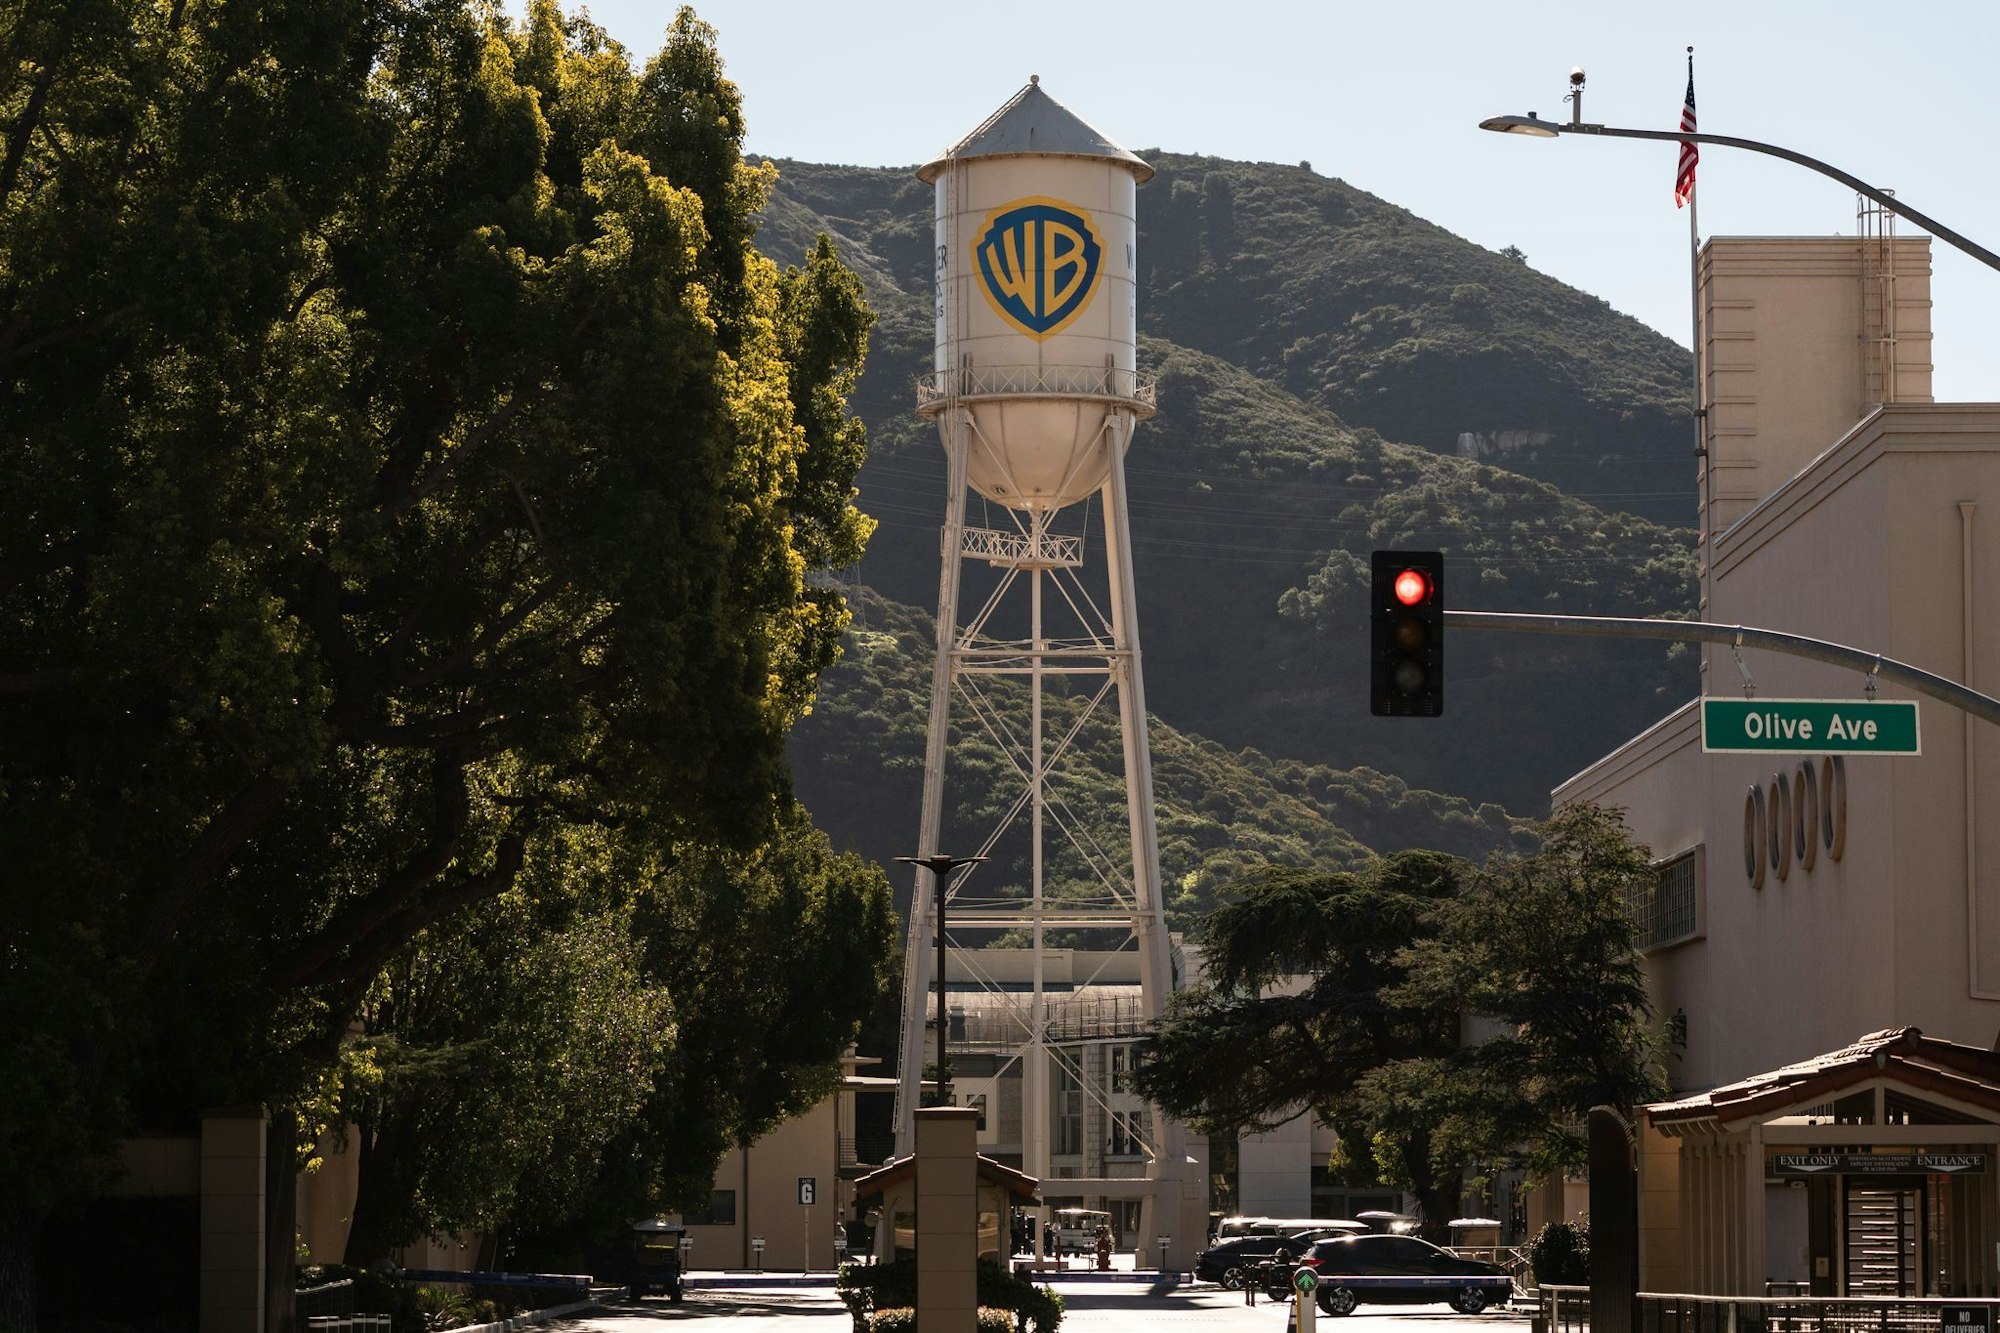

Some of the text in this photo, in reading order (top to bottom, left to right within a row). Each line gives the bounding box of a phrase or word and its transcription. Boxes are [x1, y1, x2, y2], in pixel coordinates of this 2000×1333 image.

[986, 220, 1088, 318] WB
[1745, 712, 1878, 741] Olive Ave
[1780, 1156, 1807, 1165] EXIT
[1810, 1156, 1840, 1165] ONLY
[1917, 1156, 1980, 1165] ENTRANCE
[1959, 1311, 1970, 1322] NO
